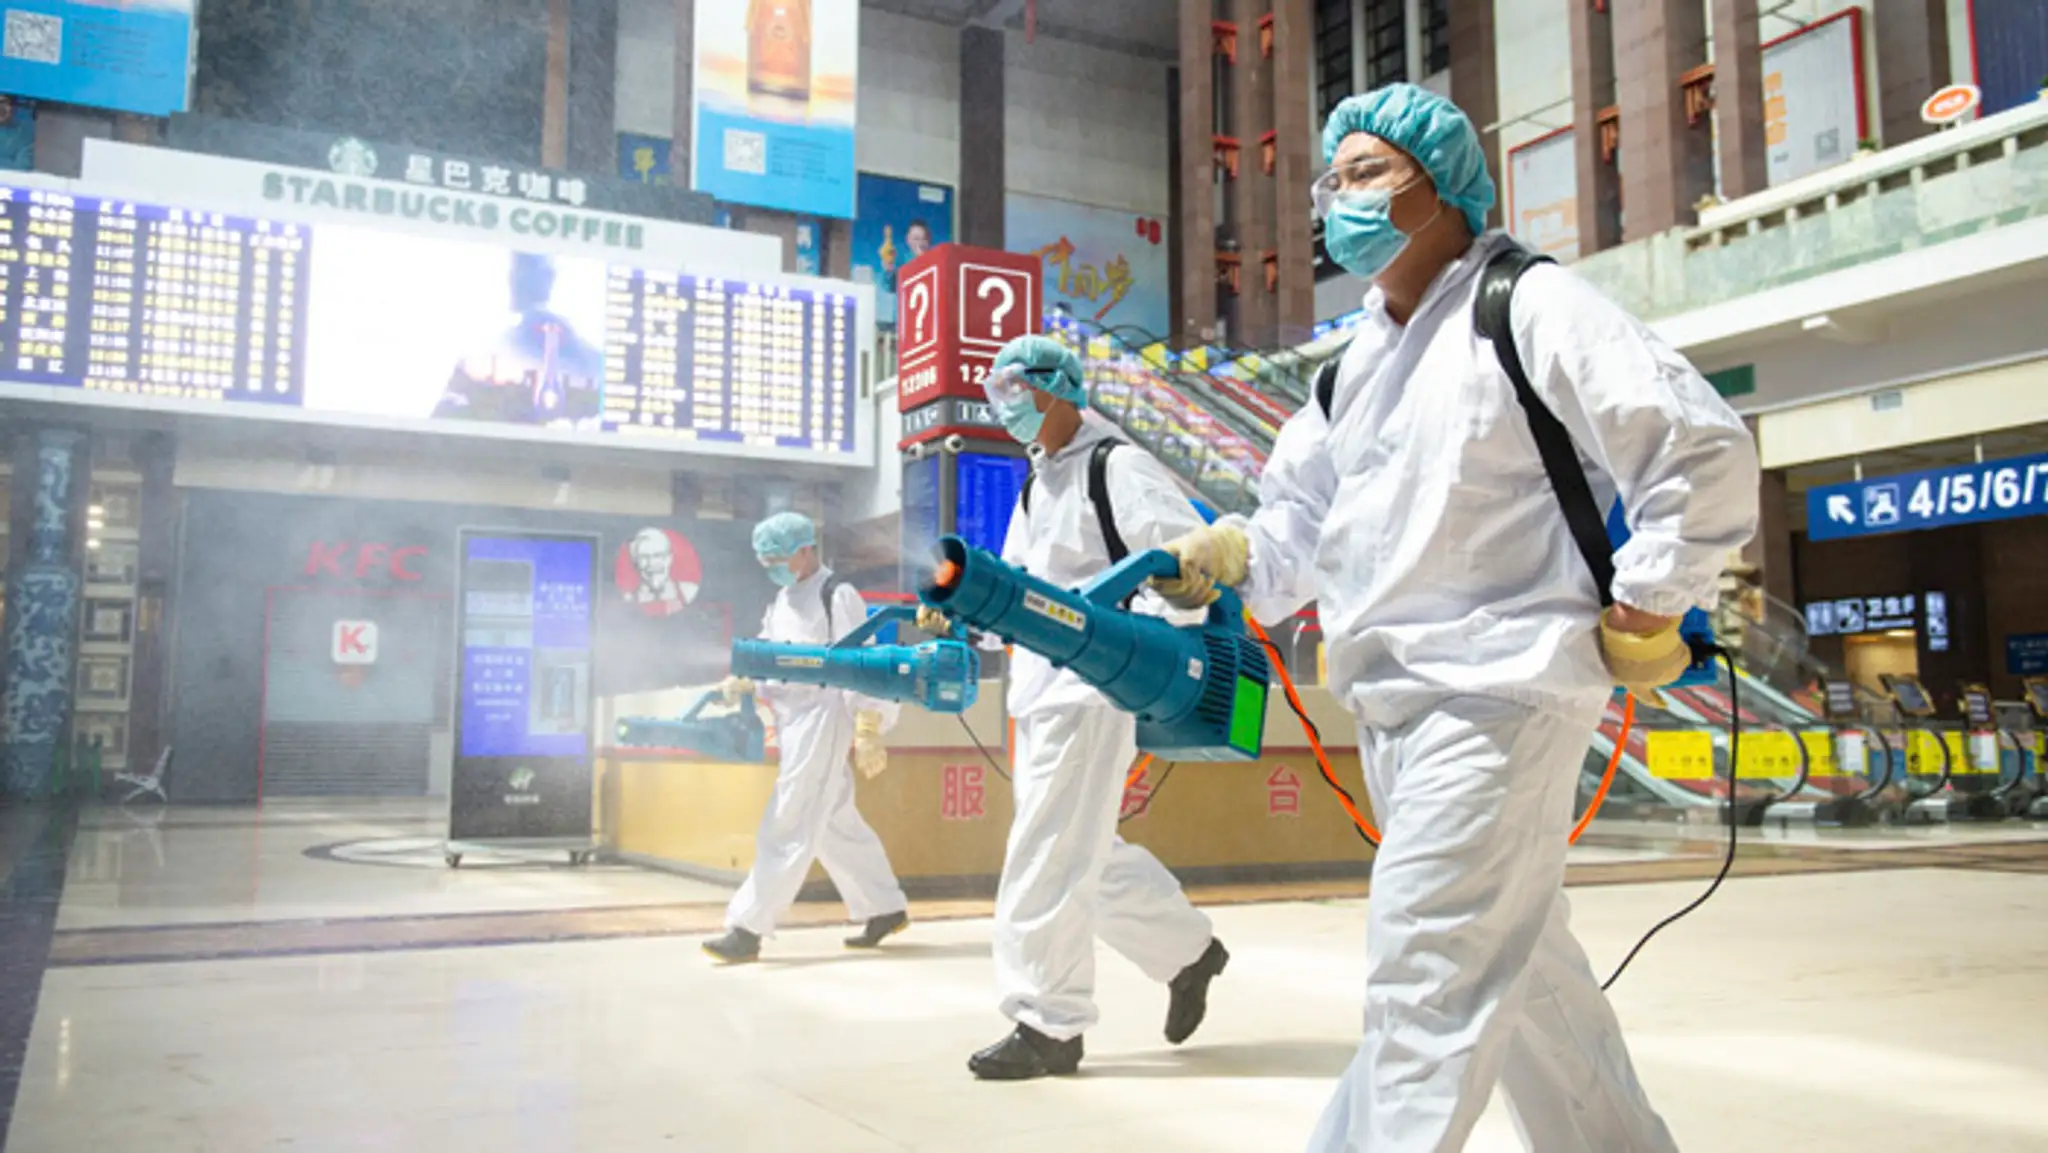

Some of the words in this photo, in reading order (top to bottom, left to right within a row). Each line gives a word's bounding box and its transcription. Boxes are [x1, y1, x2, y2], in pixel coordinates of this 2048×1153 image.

[405, 154, 588, 206] 星巴克咖啡
[262, 171, 499, 230] STARBUCKS
[509, 207, 645, 250] COFFEE
[304, 540, 429, 581] KFC
